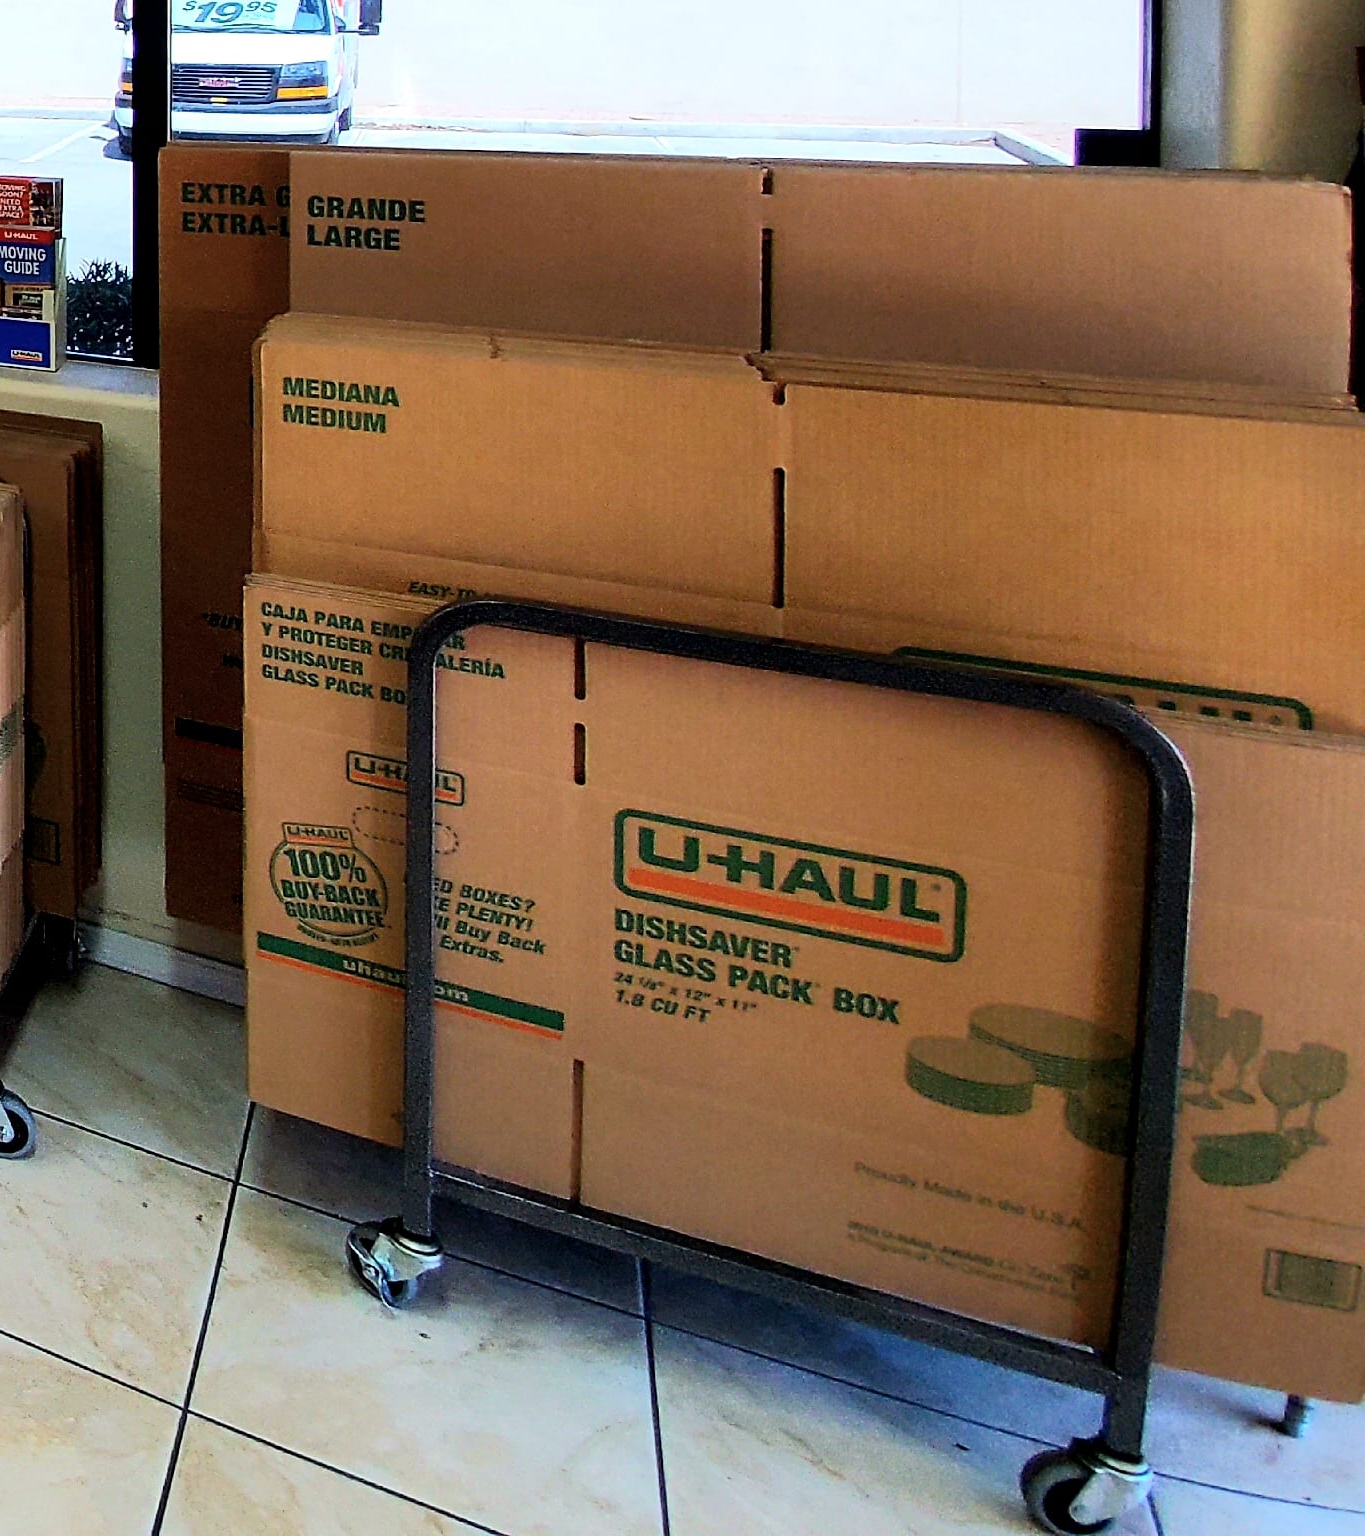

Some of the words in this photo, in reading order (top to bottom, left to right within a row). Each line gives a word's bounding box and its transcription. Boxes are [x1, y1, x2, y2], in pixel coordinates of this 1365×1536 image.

[0, 198, 21, 206] NEED
[181, 182, 266, 206] EXTRA
[307, 195, 427, 223] GRANDE
[307, 225, 401, 251] LARGE
[4, 261, 40, 275] GUIDE
[283, 376, 400, 407] MEDIANA
[283, 403, 388, 433] MEDIUM
[261, 601, 309, 623] CAJA
[314, 611, 365, 633] PARA
[262, 623, 273, 636] Y
[279, 627, 372, 655] PROTEGER
[262, 644, 364, 676] DISHSAVER
[262, 665, 319, 688] GLASS
[325, 676, 374, 700] PACK
[282, 849, 368, 884] 100%
[638, 826, 941, 923] U-HAUL
[280, 879, 382, 909] BUY-BACK
[460, 884, 537, 913] BOXES?
[455, 901, 534, 932] PLENTY!
[439, 934, 505, 964] Extras.
[455, 918, 494, 942] Buy
[498, 930, 548, 955] Back
[614, 908, 799, 969] DISHSAVER
[614, 939, 717, 984] GLASS
[728, 967, 819, 1005] PACK
[833, 987, 901, 1025] BOX
[614, 989, 645, 1009] 1.8
[650, 997, 678, 1017] CU
[682, 1005, 711, 1023] FT
